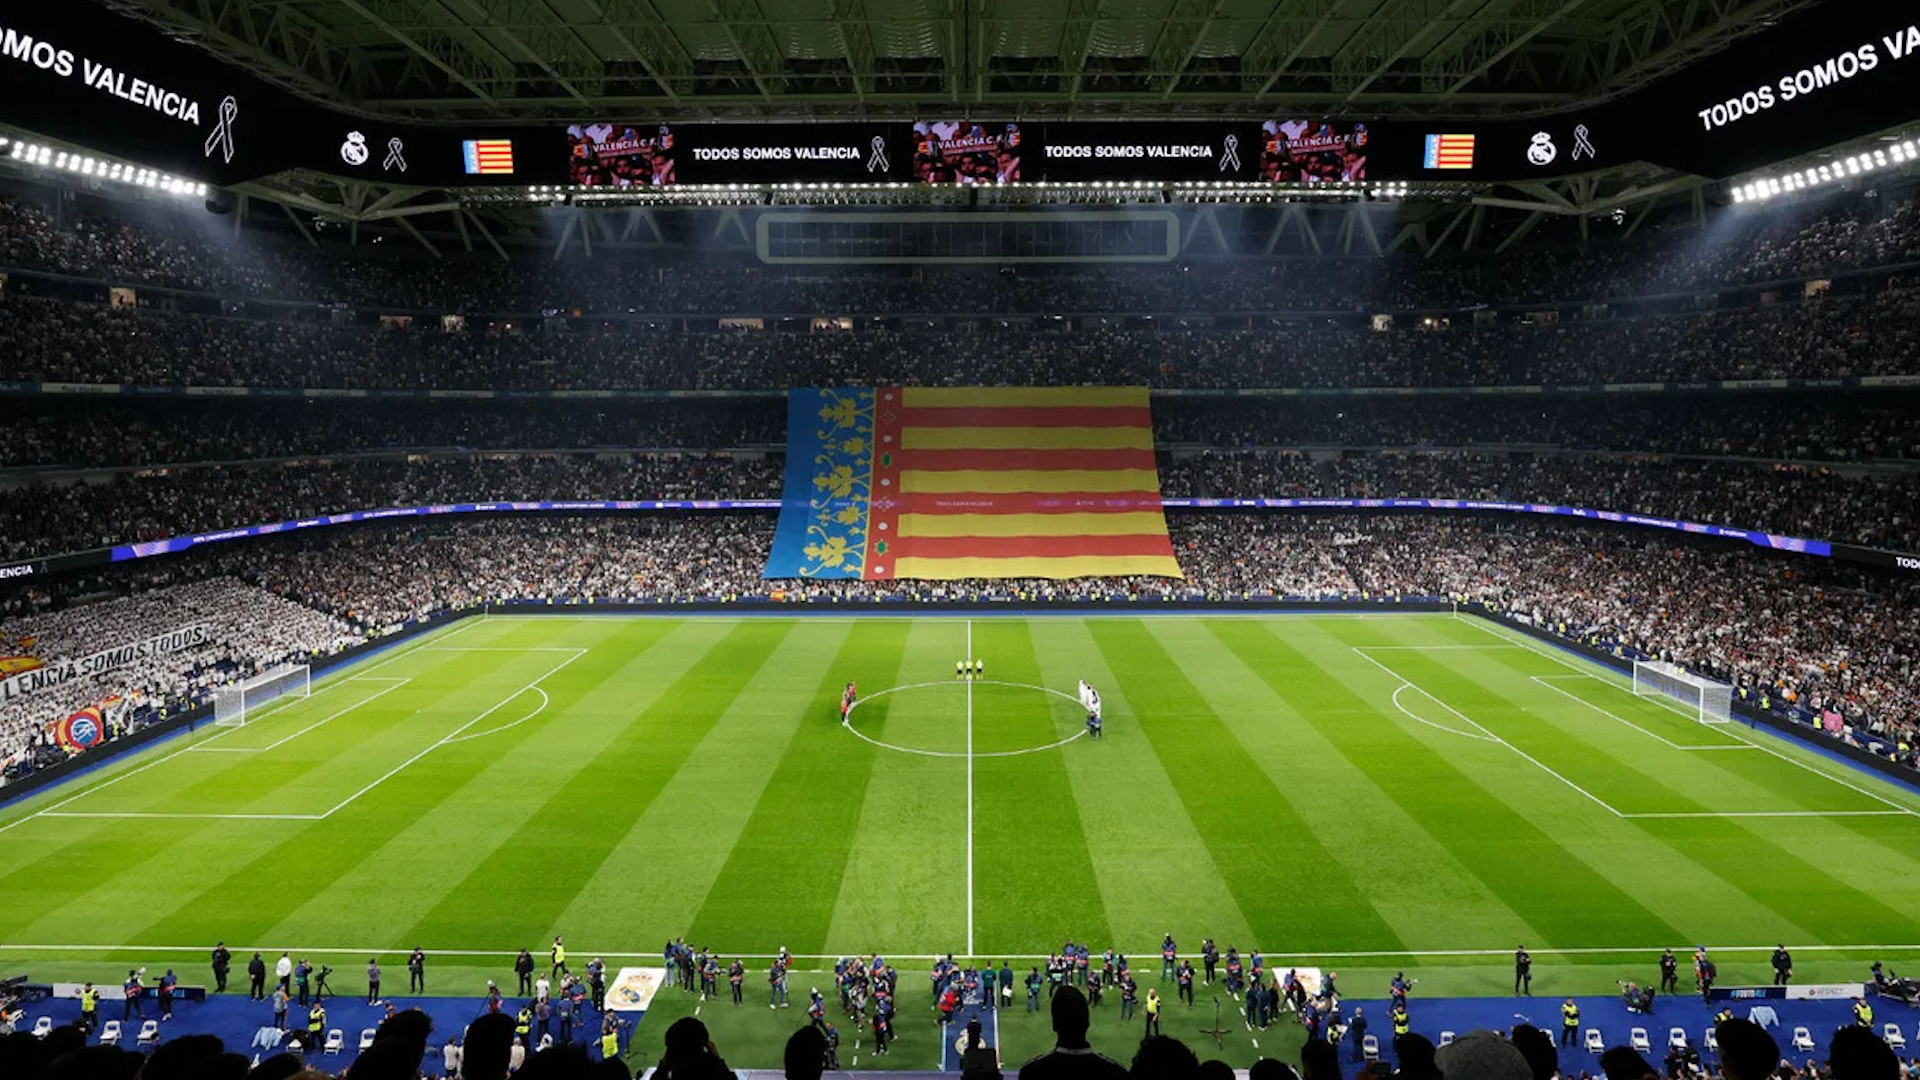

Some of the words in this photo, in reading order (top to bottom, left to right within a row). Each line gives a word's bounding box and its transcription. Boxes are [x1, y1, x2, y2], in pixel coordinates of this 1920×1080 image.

[0, 27, 75, 77] MOS
[83, 57, 200, 125] VALENCIA
[1699, 86, 1776, 131] TODOS
[1779, 44, 1879, 100] SOMOS
[1882, 25, 1920, 60] VA
[592, 140, 640, 153] VALENCIA
[938, 136, 985, 150] VALENCIA
[1285, 135, 1333, 149] VALENCIA
[693, 147, 740, 161] TODOS
[743, 147, 792, 160] SOMOS
[794, 146, 860, 160] VALENCIA
[1045, 145, 1092, 158] TODOS
[1095, 145, 1144, 158] SOMOS
[1147, 145, 1212, 158] VALENCIA
[1895, 556, 1920, 570] TOD
[0, 564, 33, 579] ENCIA
[81, 643, 147, 675] SOMOS
[150, 627, 203, 655] TODOS
